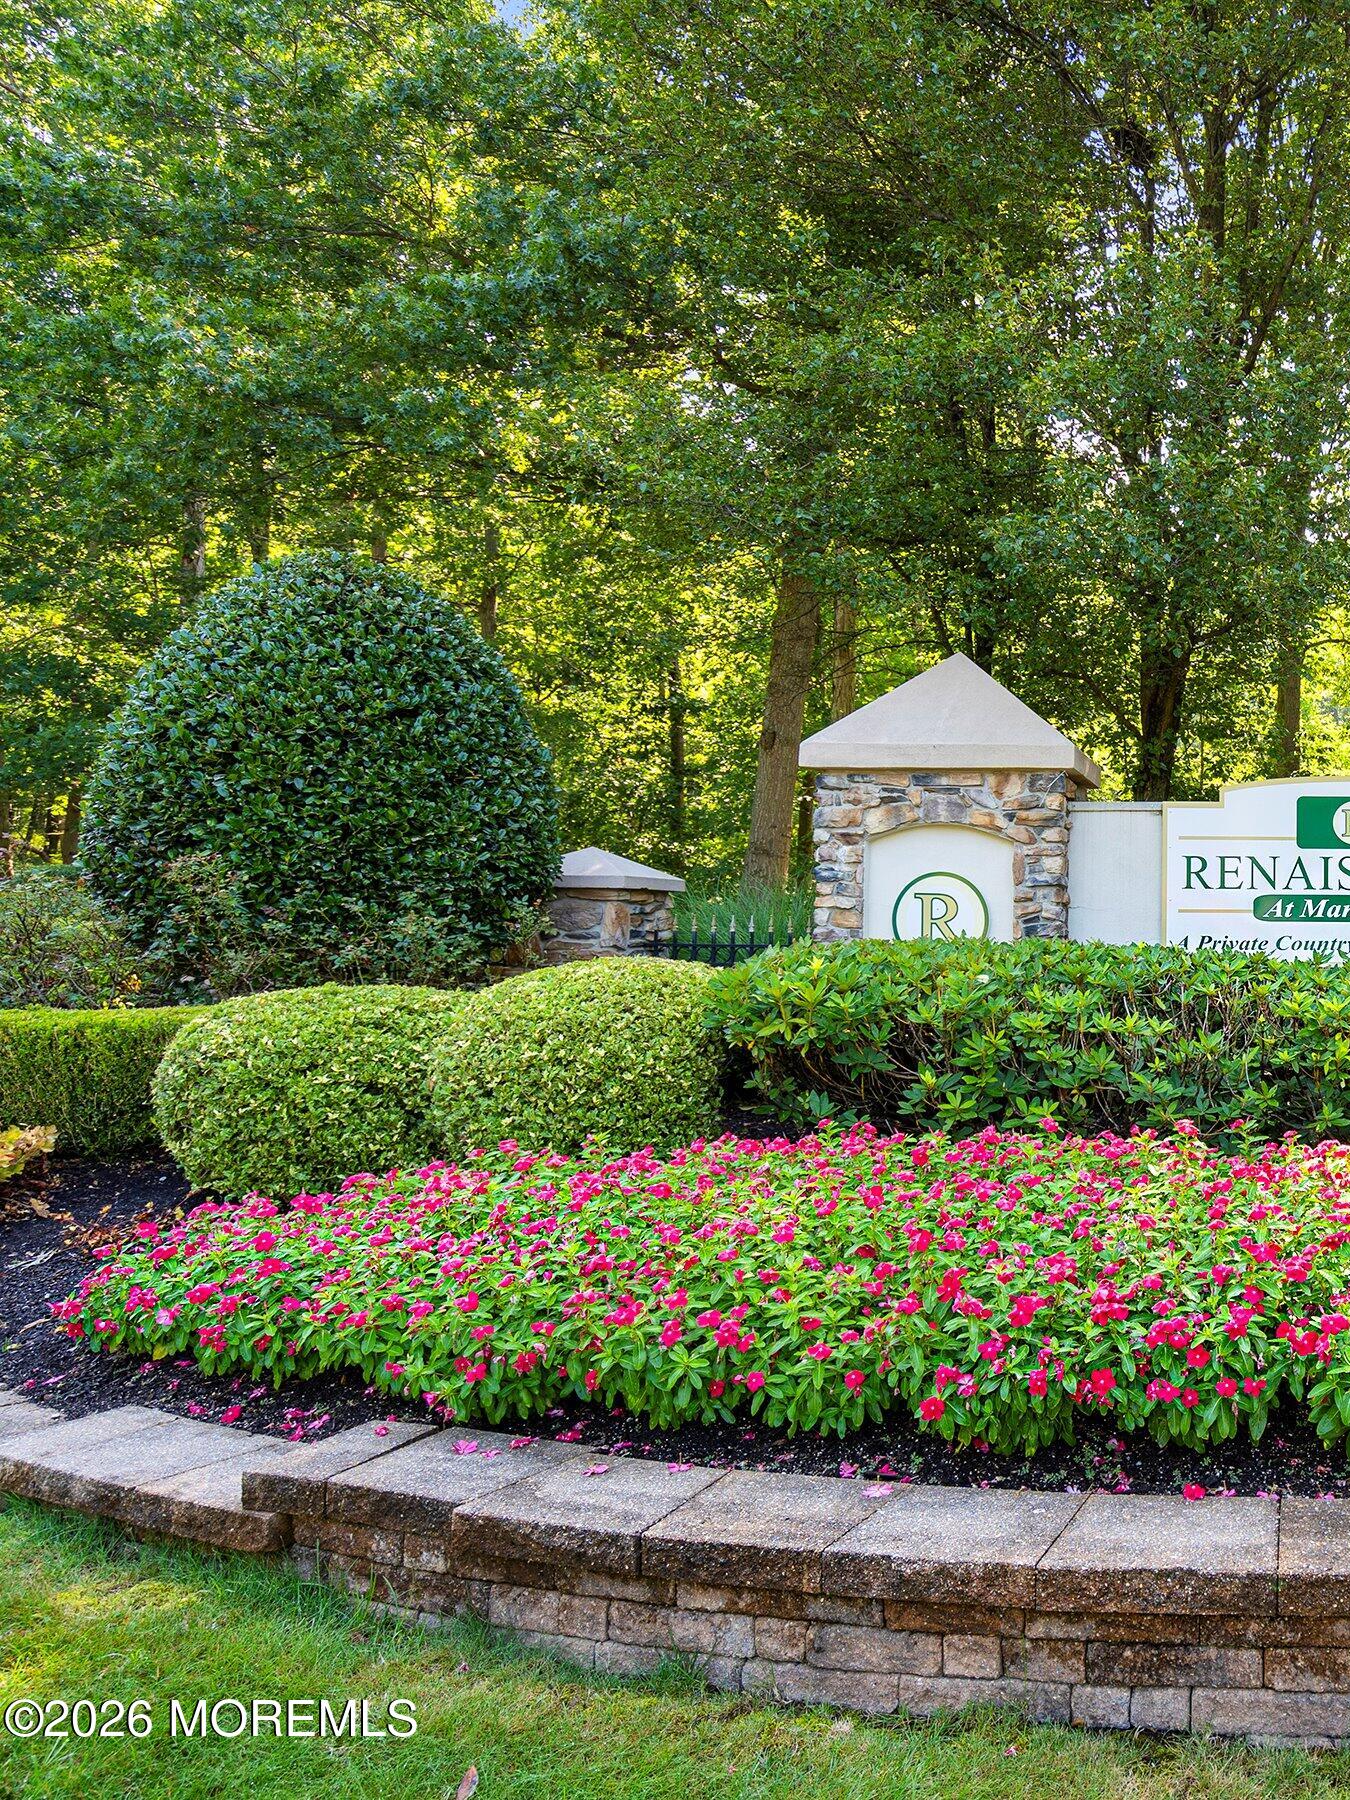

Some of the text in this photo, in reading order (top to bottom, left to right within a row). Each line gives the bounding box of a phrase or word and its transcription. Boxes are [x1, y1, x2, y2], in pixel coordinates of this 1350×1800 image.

[913, 892, 959, 943] R
[1263, 898, 1295, 918] At
[1178, 935, 1190, 951] A
[1198, 934, 1269, 951] Private
